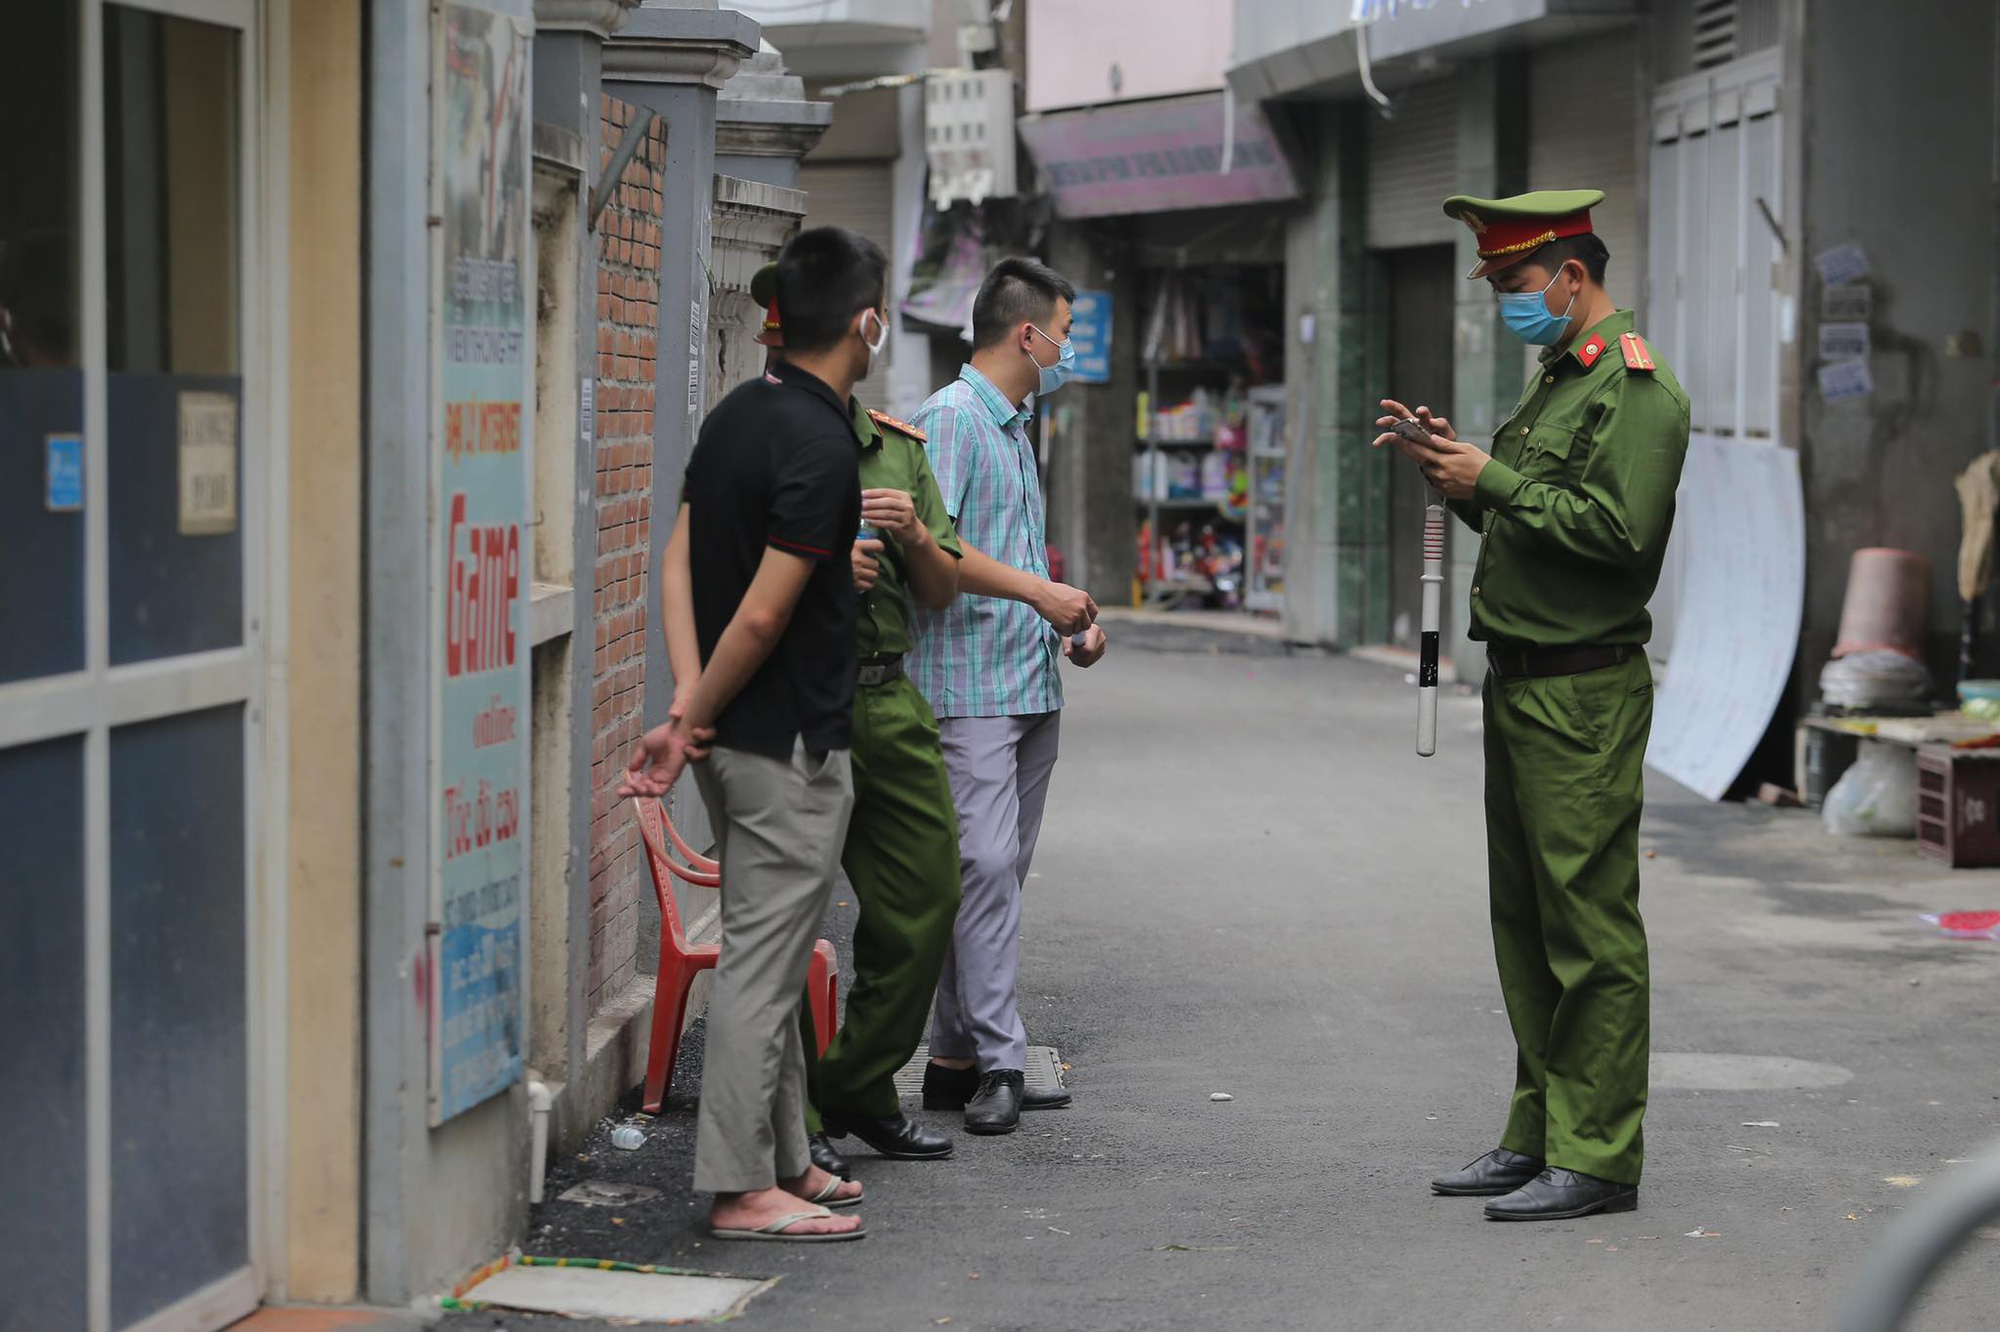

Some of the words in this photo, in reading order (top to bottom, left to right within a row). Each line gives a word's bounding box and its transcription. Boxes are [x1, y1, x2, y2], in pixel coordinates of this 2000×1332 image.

[447, 492, 518, 677] Game
[473, 692, 516, 748] online
[496, 787, 518, 842] cao
